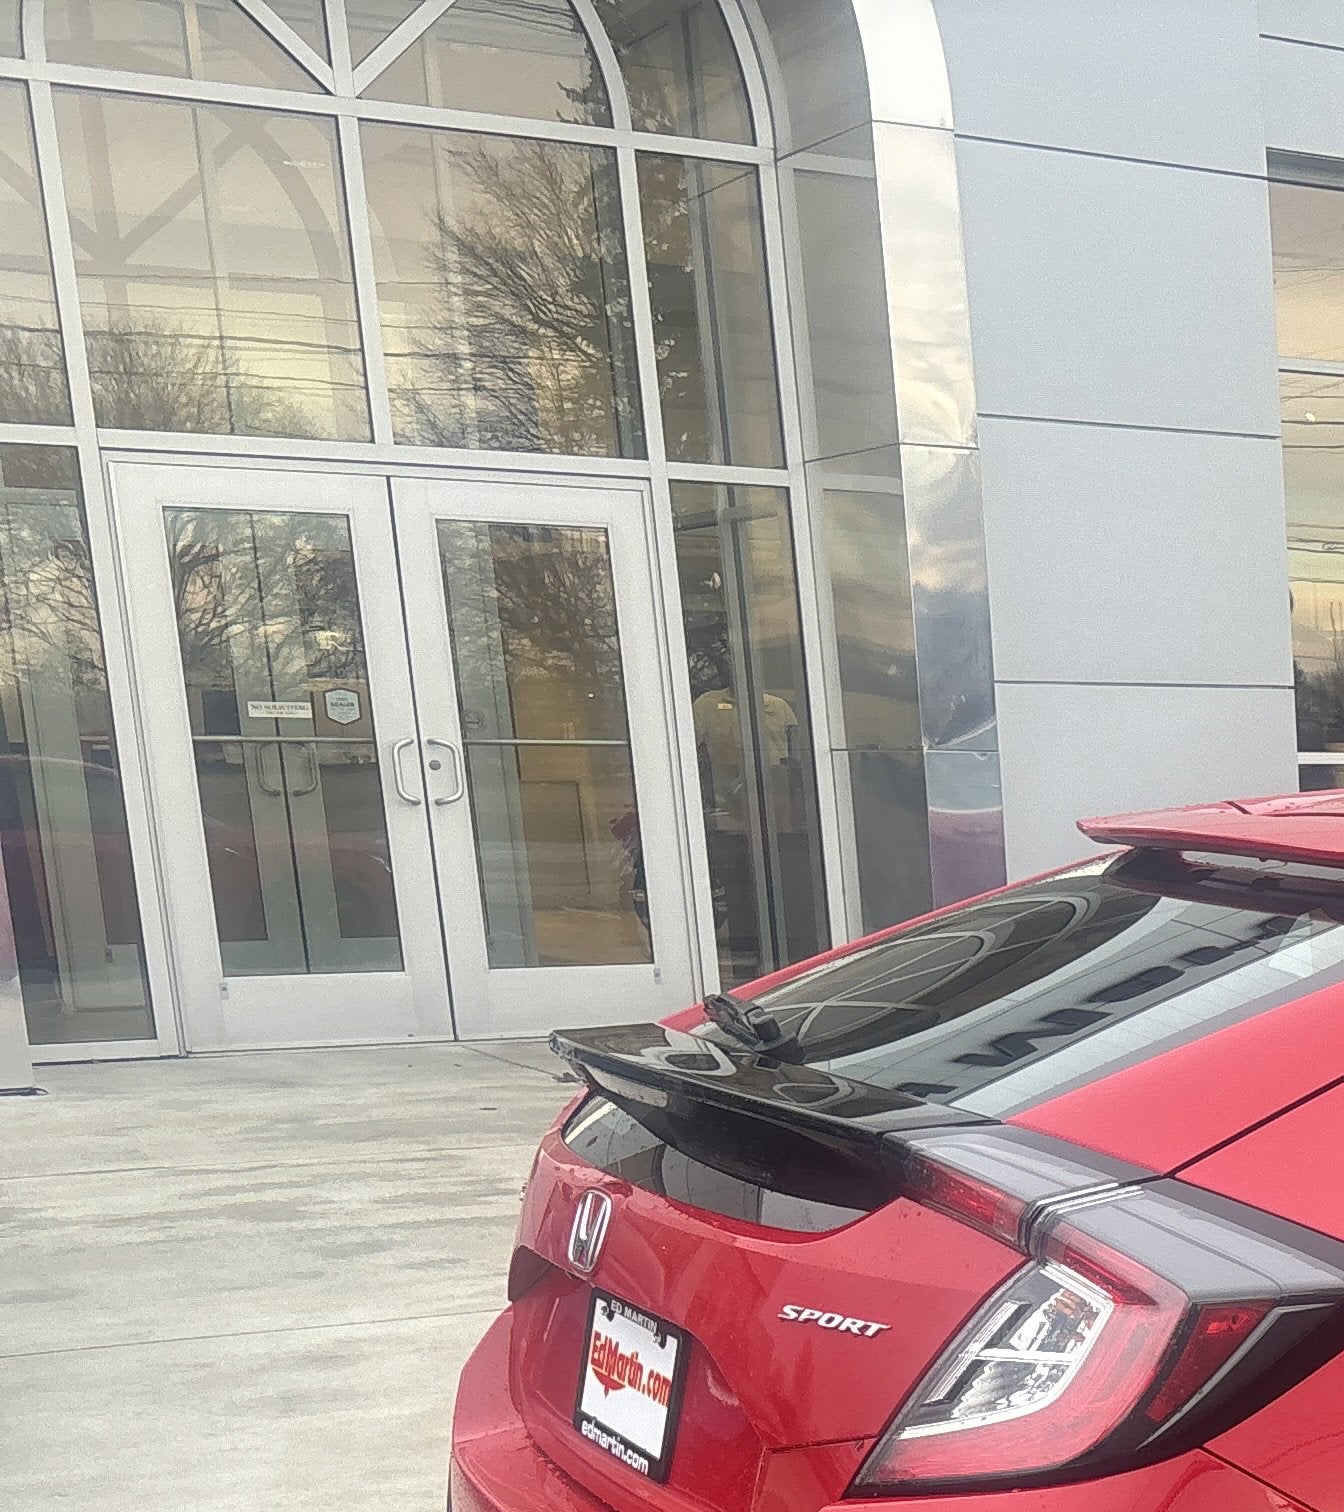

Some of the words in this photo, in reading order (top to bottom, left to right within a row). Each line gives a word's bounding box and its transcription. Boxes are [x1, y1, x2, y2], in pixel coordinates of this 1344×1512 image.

[611, 1299, 623, 1314] ED
[624, 1306, 658, 1334] MARTIN
[777, 1304, 893, 1338] SPORT
[591, 1330, 672, 1409] EdMartin.com
[580, 1417, 650, 1477] edmartin.com
